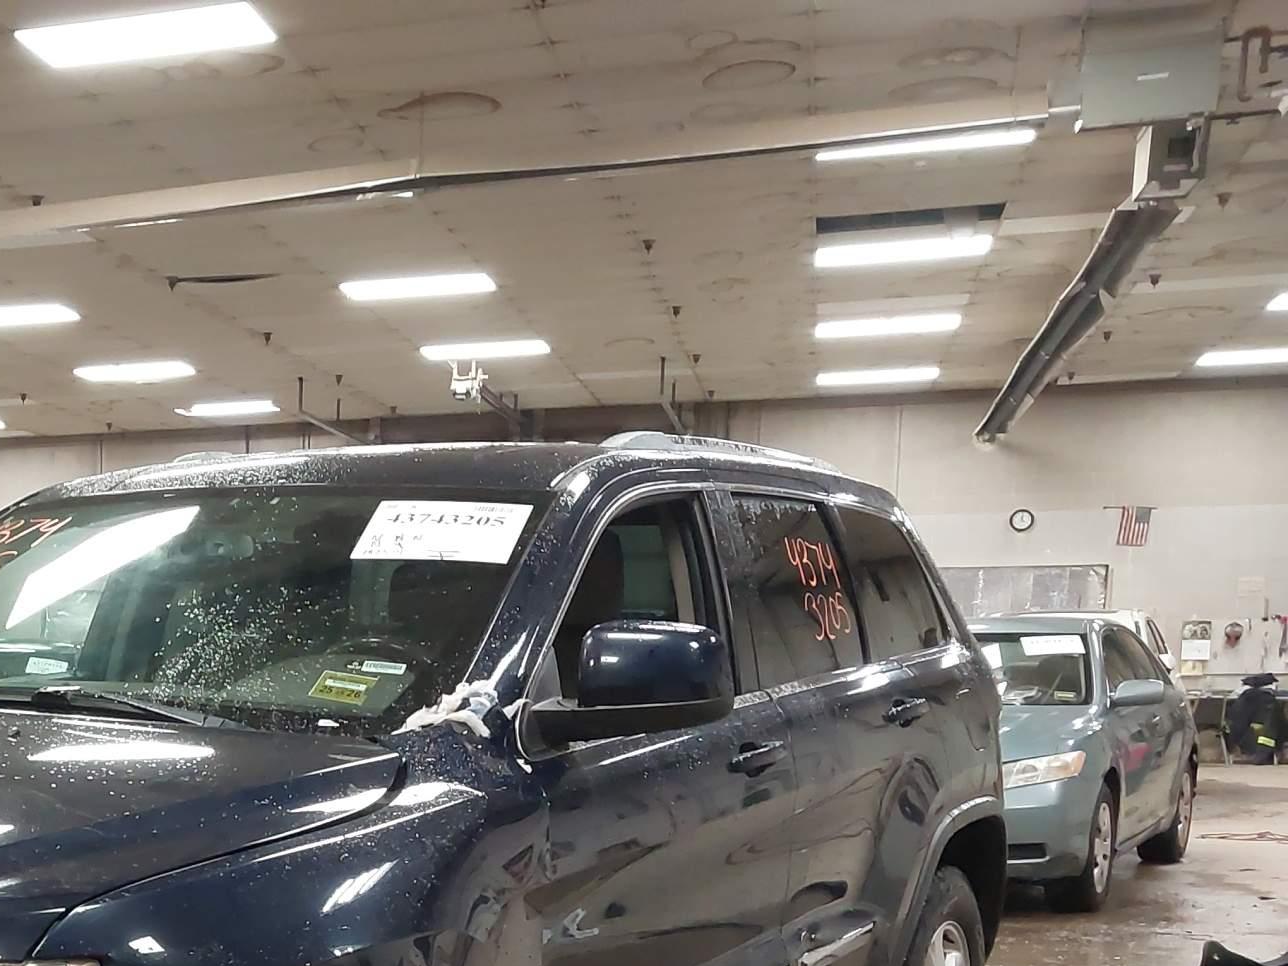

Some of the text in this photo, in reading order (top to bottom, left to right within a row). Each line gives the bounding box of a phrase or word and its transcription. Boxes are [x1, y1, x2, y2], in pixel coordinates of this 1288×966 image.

[386, 513, 507, 527] 43743205
[784, 536, 842, 590] 4374
[804, 591, 852, 641] 3205
